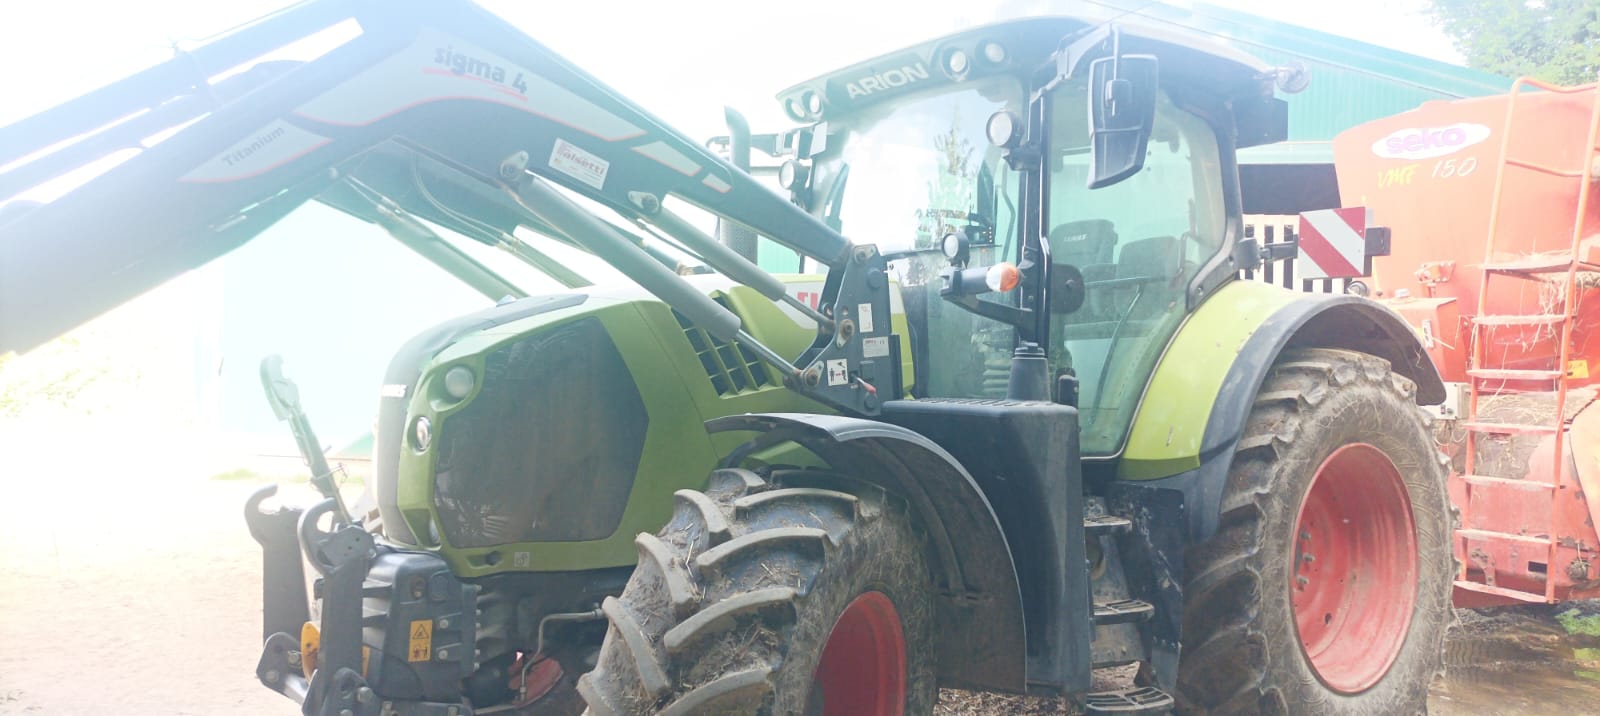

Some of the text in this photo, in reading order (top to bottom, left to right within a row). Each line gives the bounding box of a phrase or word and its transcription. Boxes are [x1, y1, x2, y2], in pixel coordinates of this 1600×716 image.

[434, 44, 528, 94] sigma 4
[846, 63, 929, 99] ARION
[222, 127, 285, 166] Titanium
[1386, 127, 1467, 155] seko
[1431, 157, 1477, 180] 150
